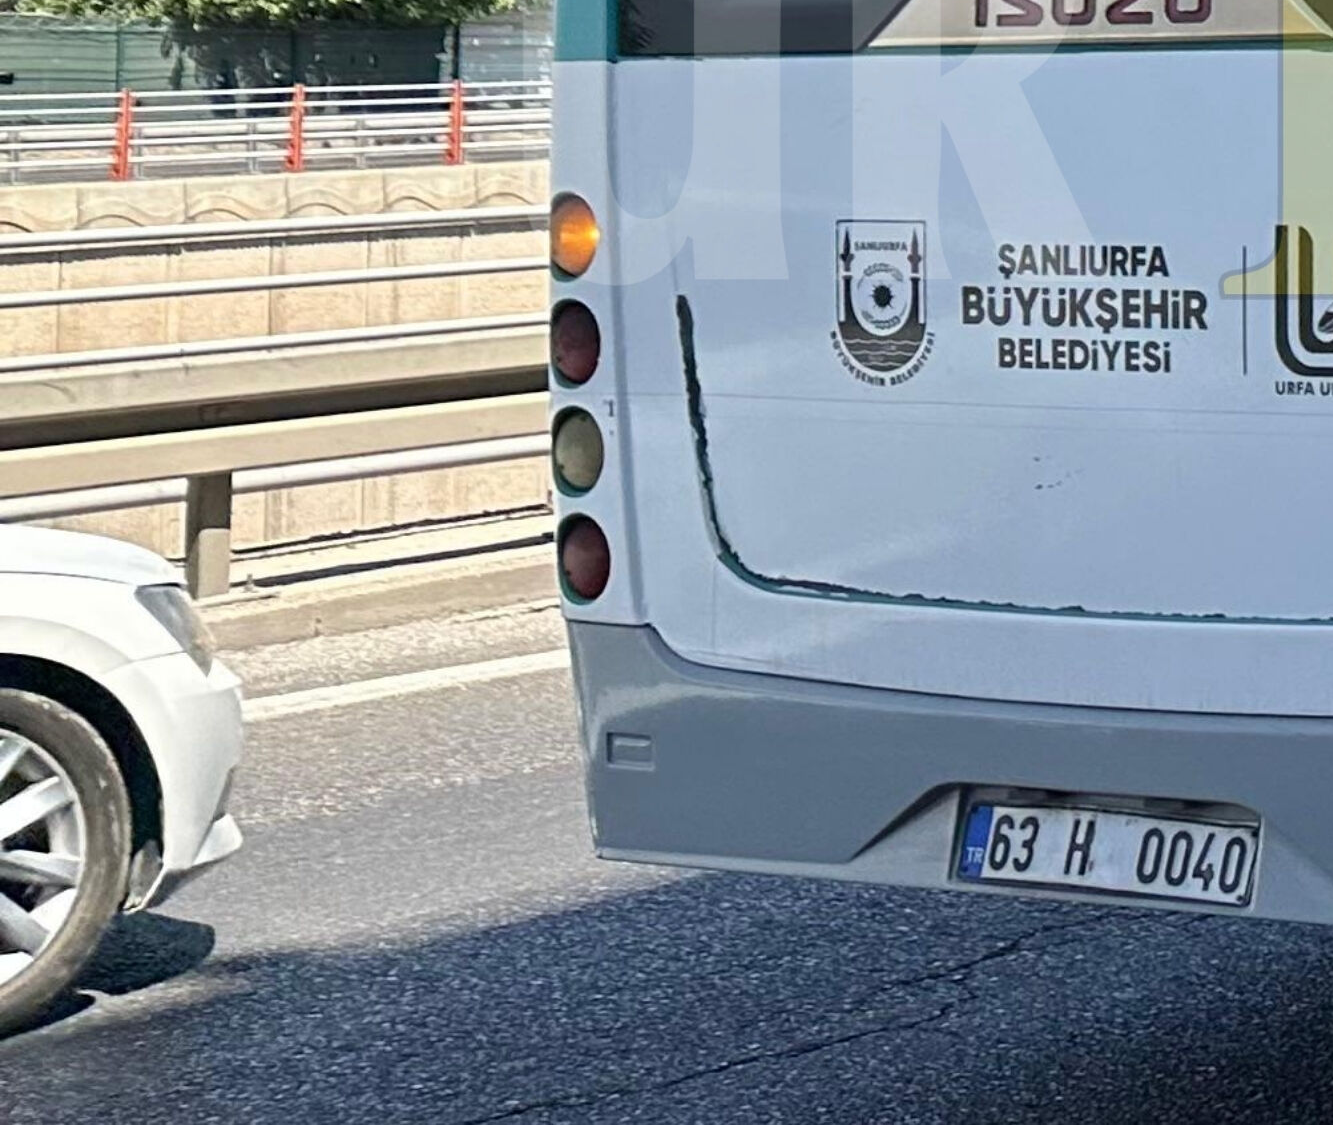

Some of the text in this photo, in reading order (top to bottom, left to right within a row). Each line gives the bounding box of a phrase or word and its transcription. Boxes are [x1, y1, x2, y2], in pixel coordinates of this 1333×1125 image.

[997, 243, 1169, 280] ŞANLIURFA
[962, 285, 1208, 331] BÜYÜKŞEHİR
[998, 338, 1172, 374] BELEDİYESİ
[1275, 380, 1315, 396] URFA
[965, 813, 1248, 894] TR 63 H 0040
